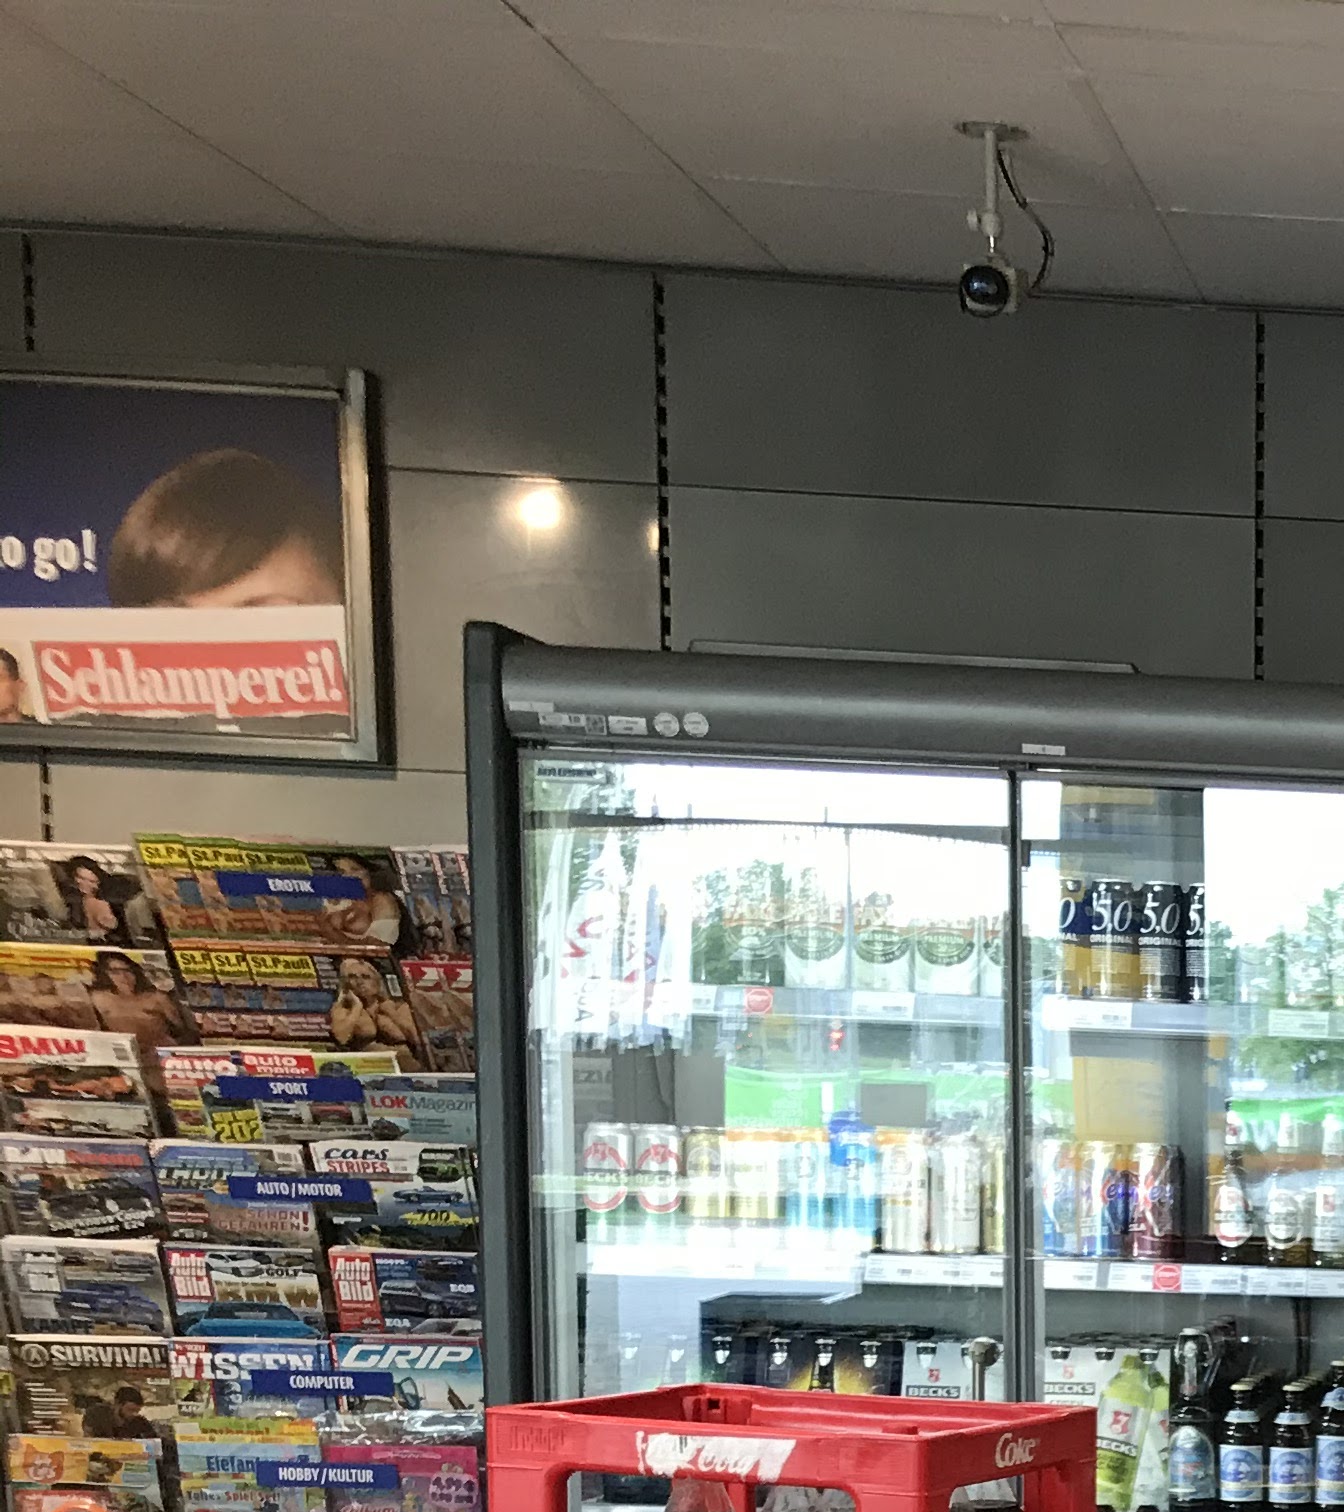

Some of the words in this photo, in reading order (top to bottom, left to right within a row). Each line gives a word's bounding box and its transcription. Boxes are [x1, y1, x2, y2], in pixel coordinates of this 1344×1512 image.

[0, 536, 27, 569] o
[33, 529, 97, 582] go!
[40, 646, 345, 719] Schlamperei!
[144, 846, 188, 864] St.Pa
[191, 849, 245, 867] St.Pau
[267, 877, 316, 894] EROTIK
[1091, 899, 1133, 931] 5,0
[1139, 900, 1181, 934] 5,0
[269, 1082, 310, 1096] SPORT
[327, 1161, 392, 1175] STRIPES
[169, 1253, 208, 1277] Auto
[334, 1257, 372, 1280] Auto
[173, 1276, 213, 1298] Bild
[338, 1279, 376, 1302] Bild
[49, 1343, 168, 1369] SURVIVAL
[341, 1344, 475, 1371] GRIP
[288, 1374, 355, 1391] COMPUTER
[907, 1386, 961, 1398] BECK'S
[995, 1432, 1036, 1469] Coke
[206, 1454, 257, 1473] Elefan
